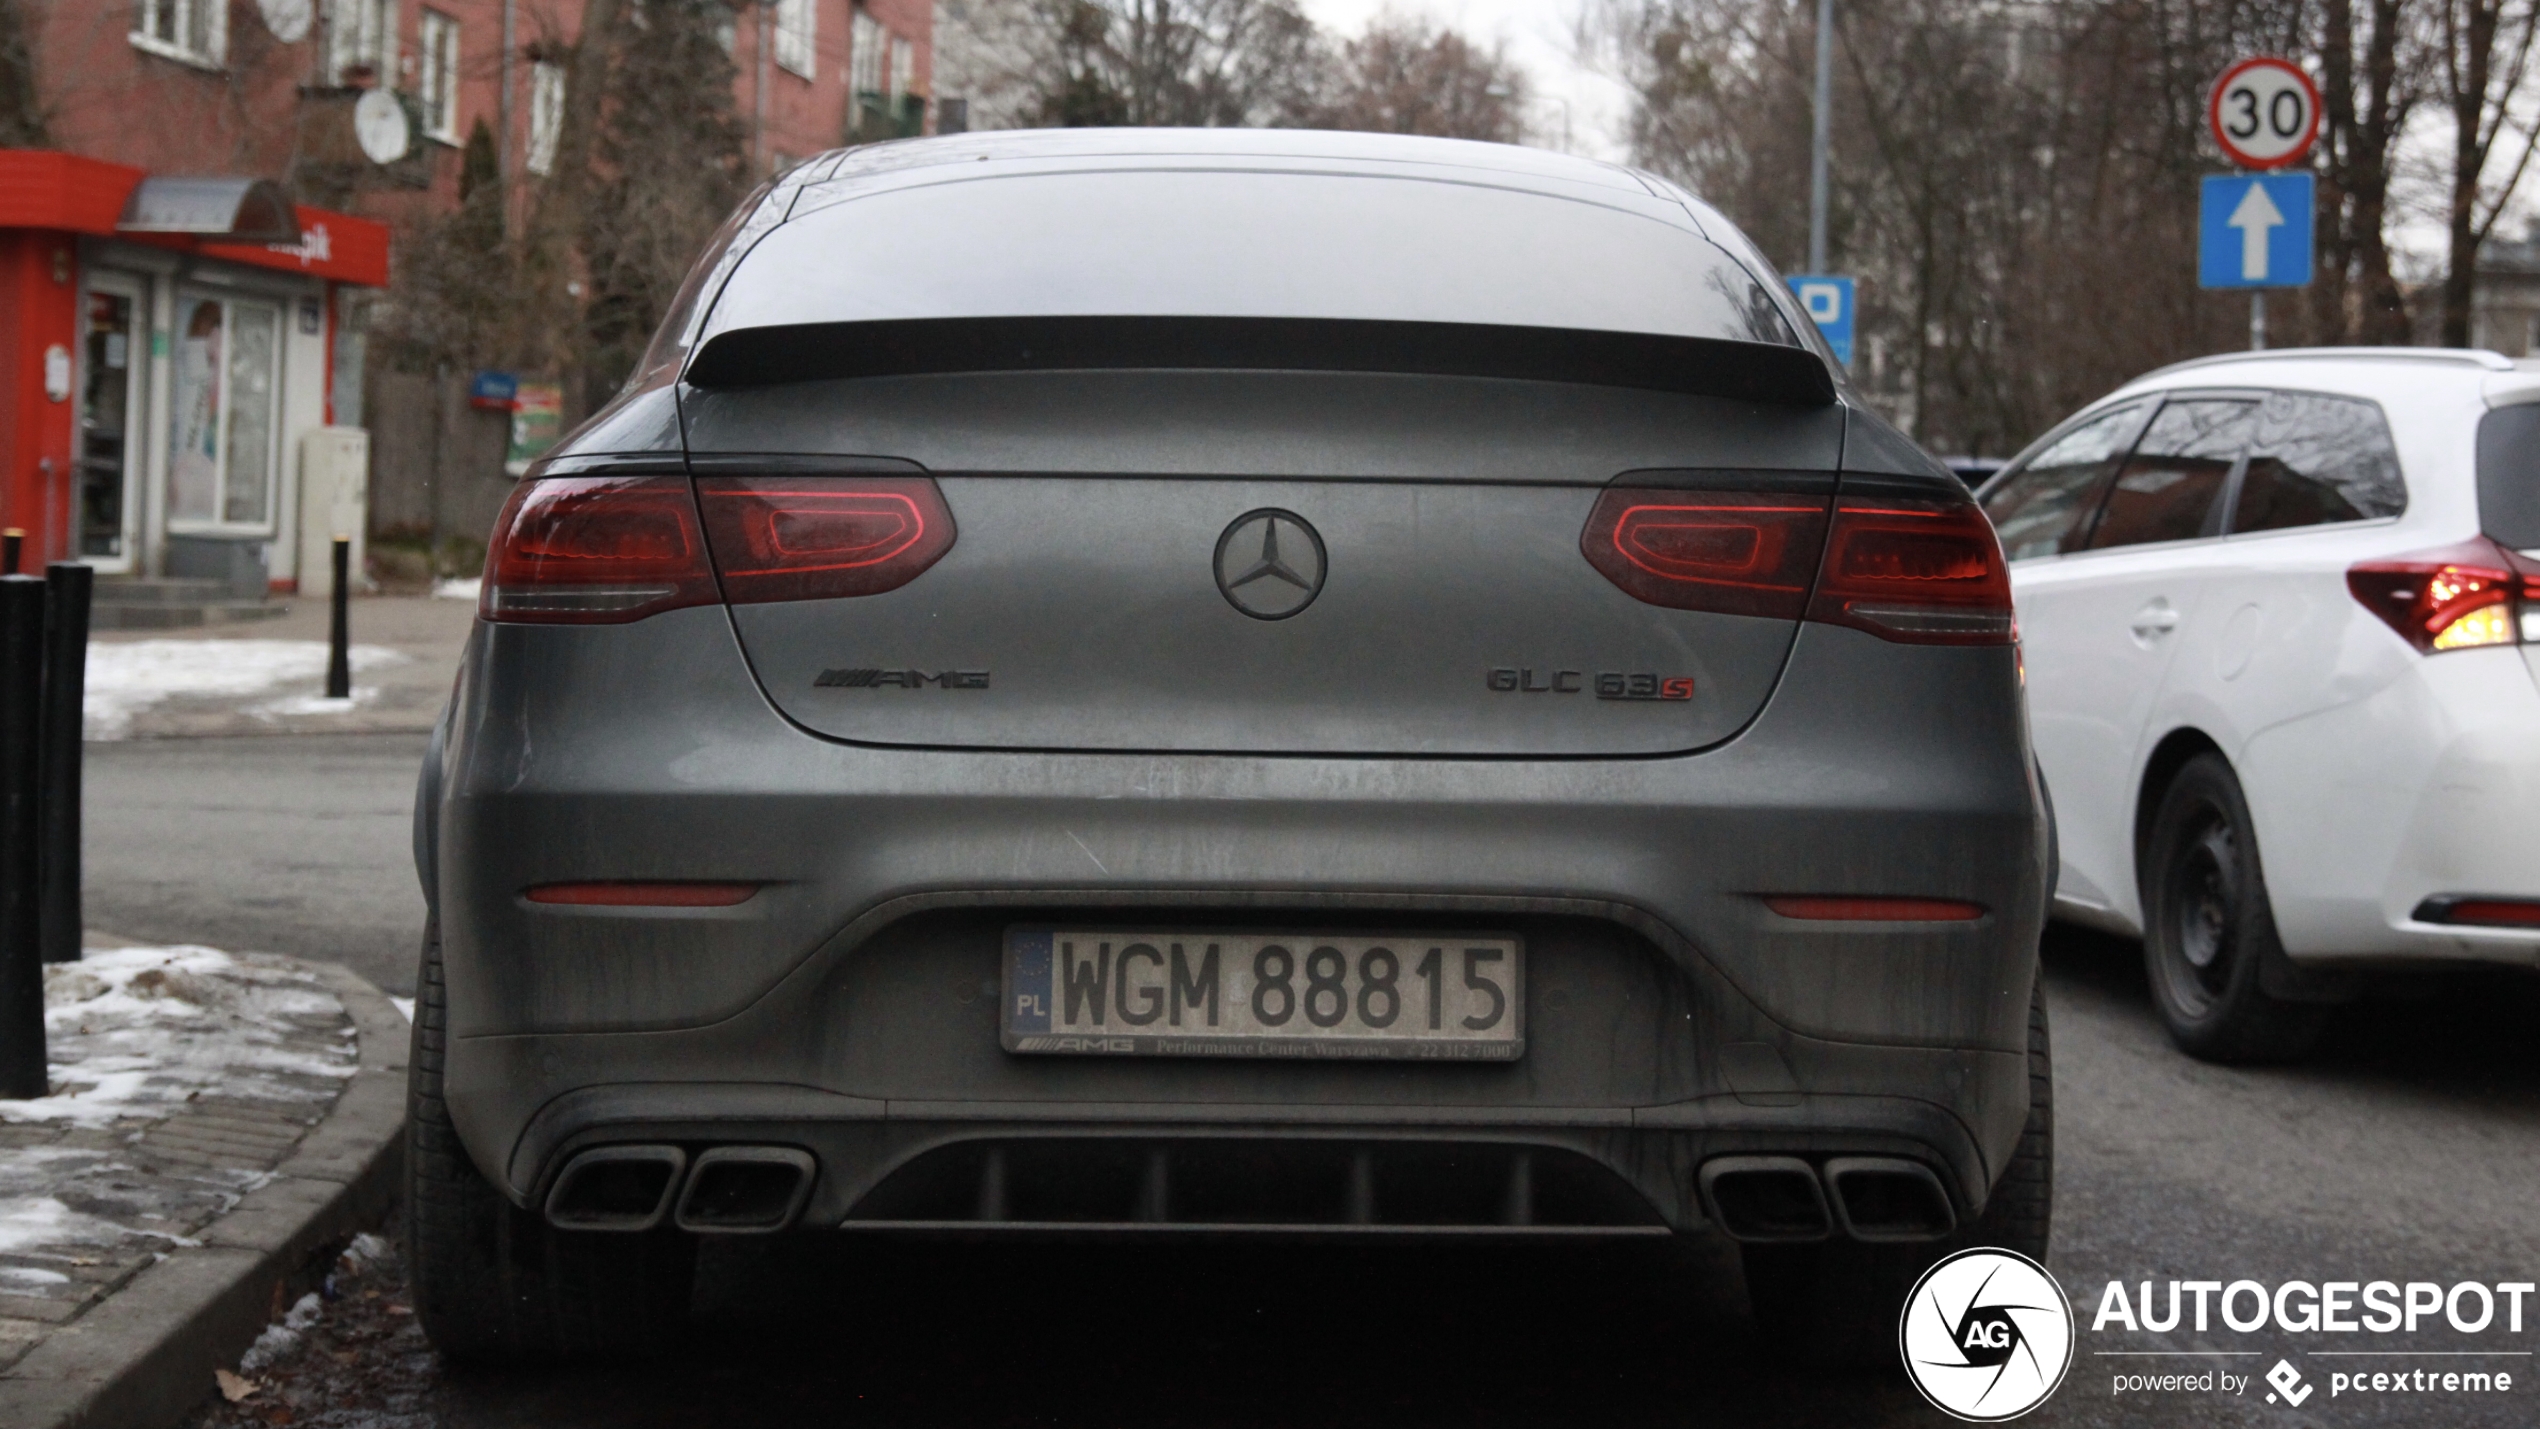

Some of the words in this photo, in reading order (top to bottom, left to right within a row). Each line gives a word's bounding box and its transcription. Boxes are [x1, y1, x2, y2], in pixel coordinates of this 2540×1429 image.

[2228, 88, 2303, 139] 30
[1486, 668, 1582, 693] GLC
[1061, 941, 1220, 1027] WGM
[1251, 944, 1506, 1031] 88815
[1016, 994, 1046, 1017] PL
[1156, 1038, 1255, 1055] Performance
[1258, 1041, 1308, 1056] Center
[1313, 1042, 1390, 1057] Warszawa
[1420, 1043, 1439, 1058] 22
[1443, 1043, 1469, 1058] 312
[1473, 1043, 1512, 1059] 7000
